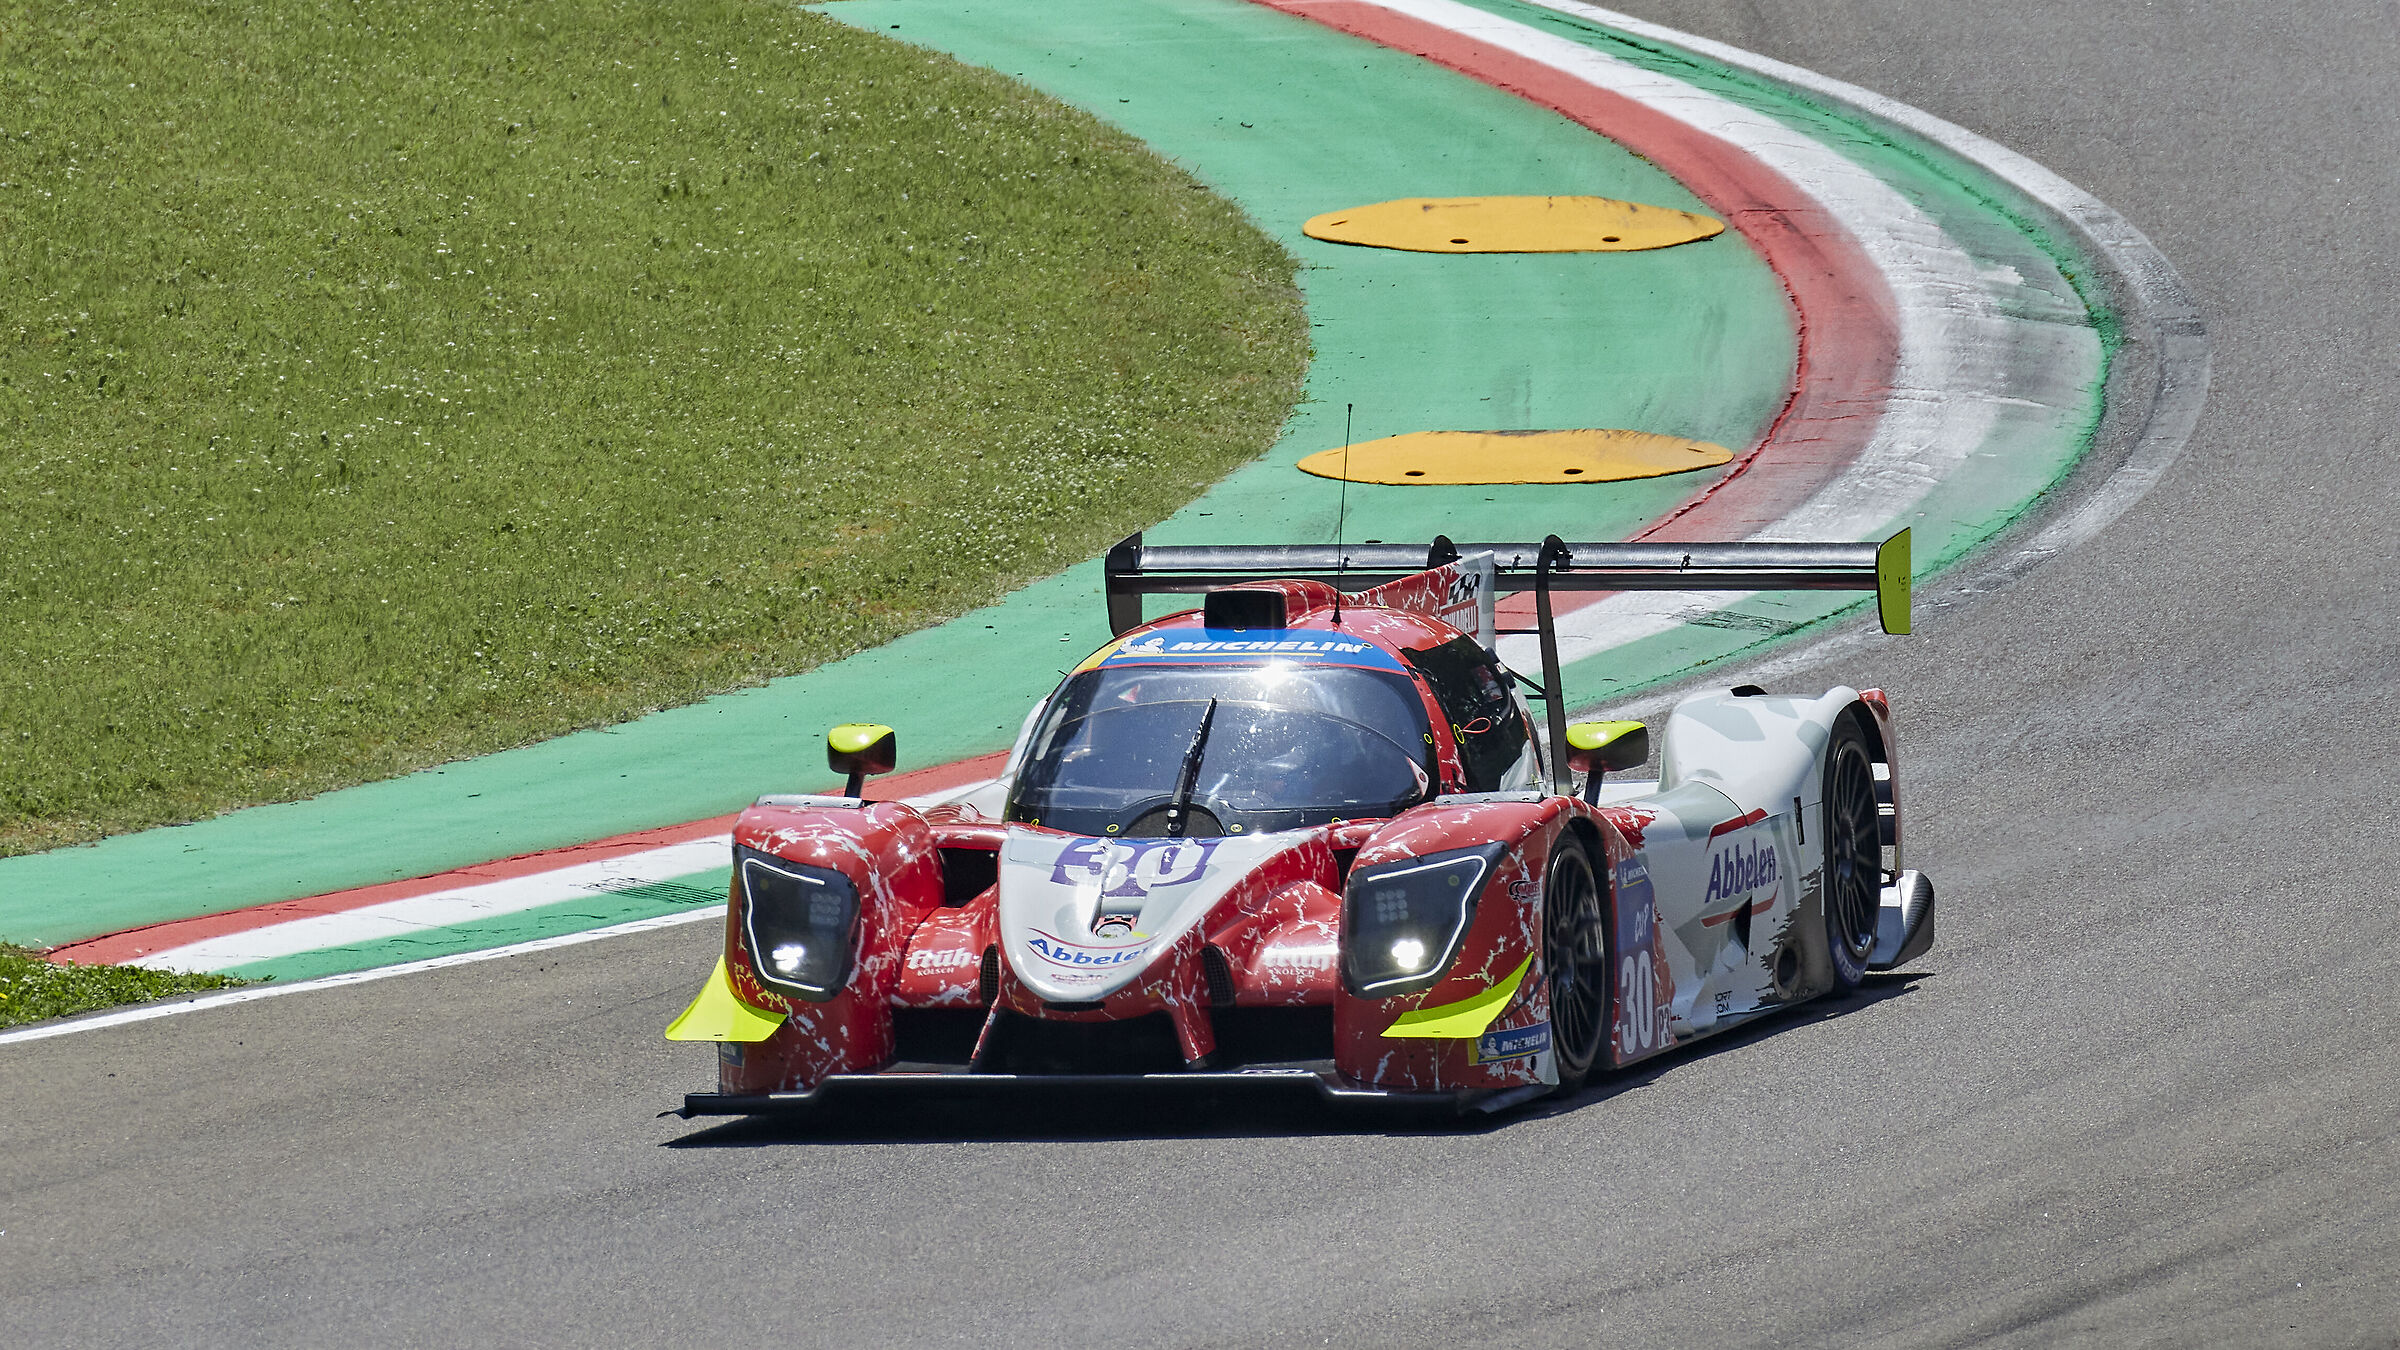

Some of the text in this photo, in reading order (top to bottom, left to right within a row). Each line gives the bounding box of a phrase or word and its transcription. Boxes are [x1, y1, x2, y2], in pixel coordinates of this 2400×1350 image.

[1170, 641, 1362, 653] MICHELIN
[1064, 842, 1204, 892] 30
[1705, 838, 1776, 903] Abbelen
[1622, 950, 1653, 1054] 30
[1502, 1032, 1547, 1052] MICHELIN
